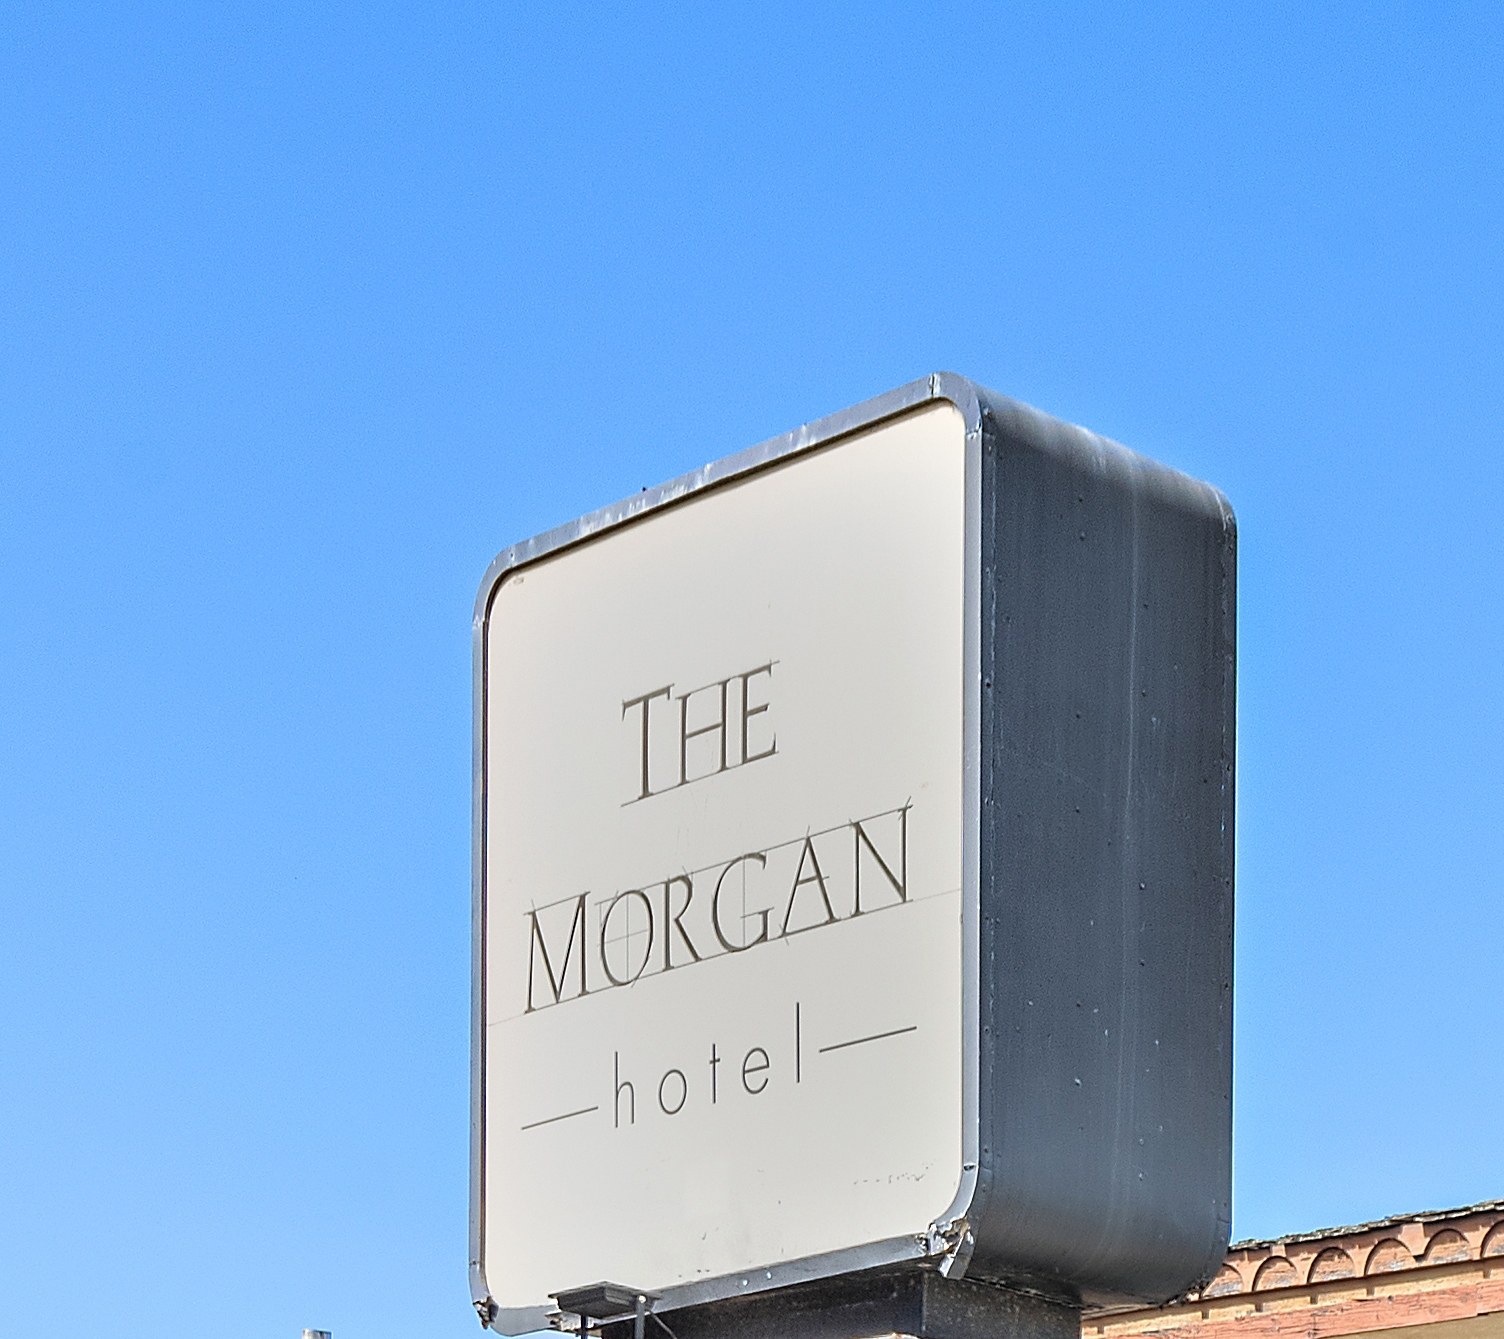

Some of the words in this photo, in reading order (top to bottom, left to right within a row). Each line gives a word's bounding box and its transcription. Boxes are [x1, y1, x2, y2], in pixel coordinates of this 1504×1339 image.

[621, 660, 780, 806] THE
[524, 797, 913, 1014] MORGAN
[615, 1002, 800, 1128] hotel
